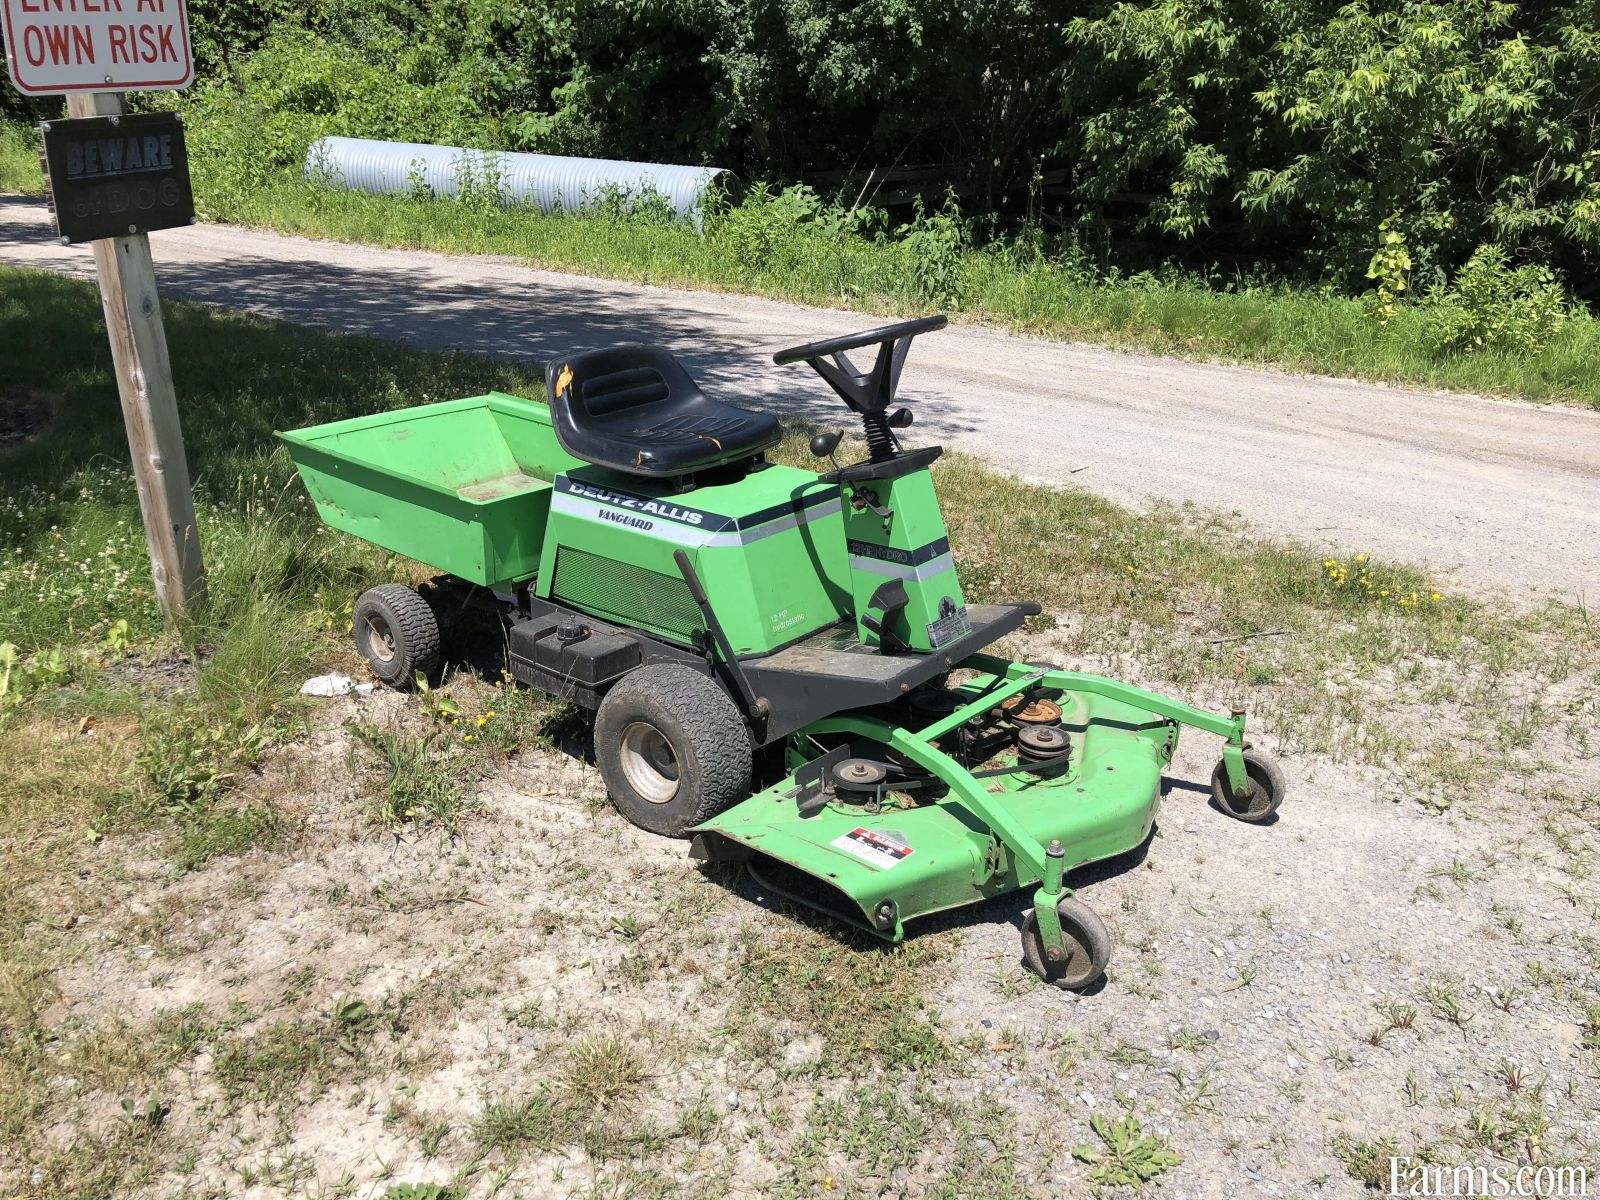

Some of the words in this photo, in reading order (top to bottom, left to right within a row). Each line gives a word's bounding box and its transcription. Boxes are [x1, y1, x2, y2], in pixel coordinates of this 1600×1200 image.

[24, 24, 95, 66] OWN
[107, 24, 179, 64] RISK
[66, 134, 172, 175] BEWARE
[107, 177, 181, 214] DOG
[568, 482, 704, 525] DEUTZ-ALLIS
[598, 509, 654, 531] VANGUARD
[770, 614, 778, 623] 12
[772, 613, 805, 633] hydrostatic
